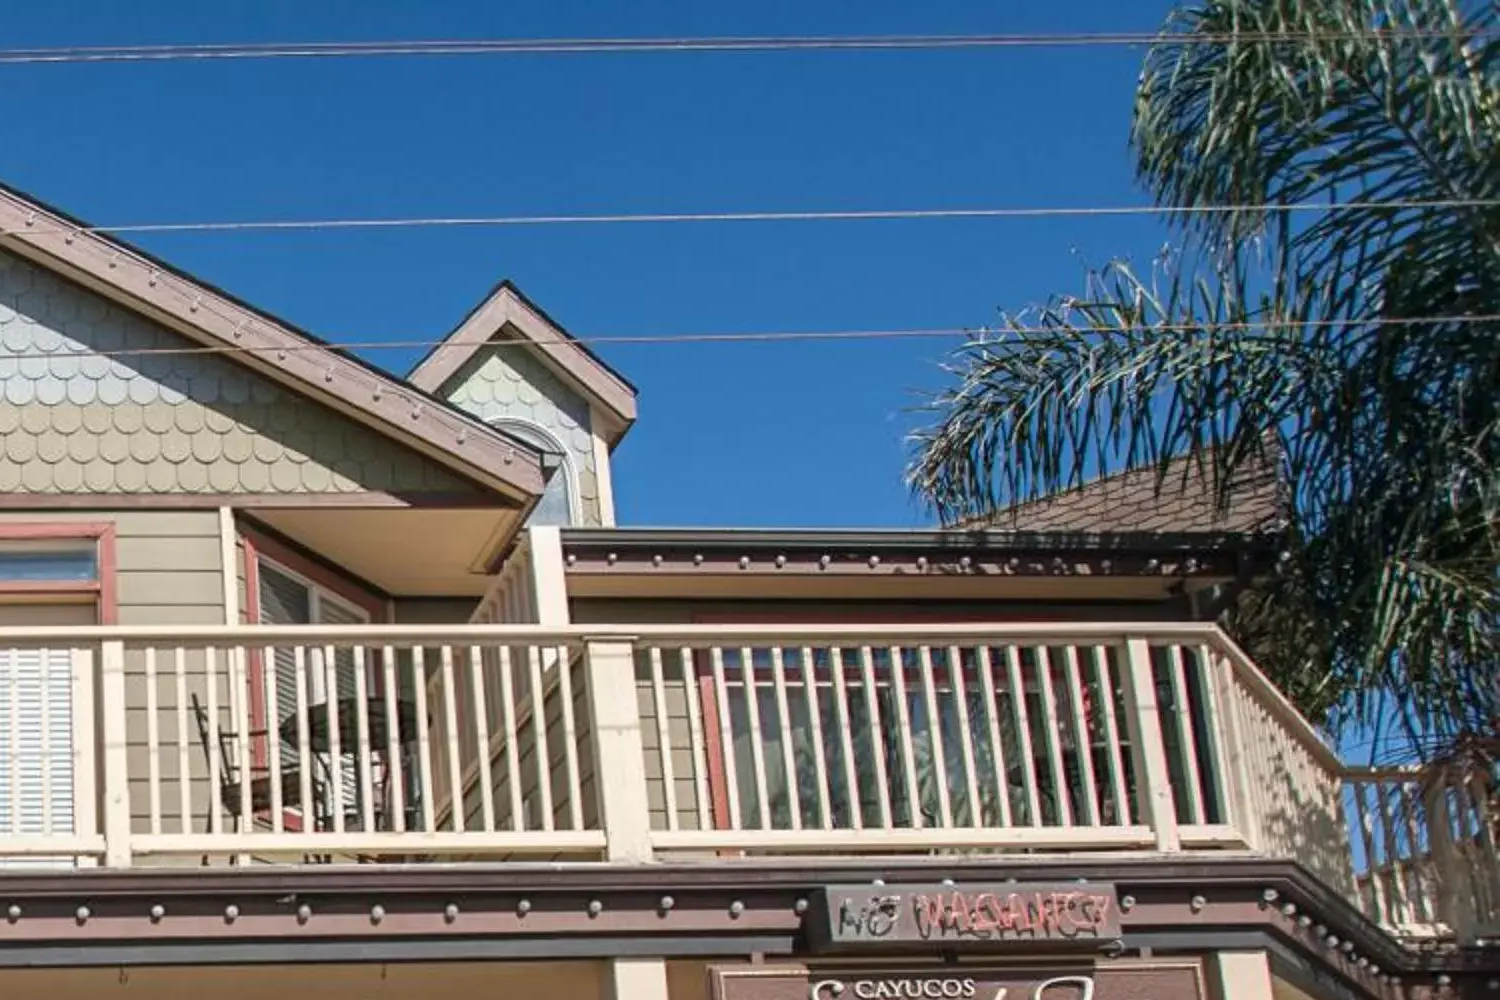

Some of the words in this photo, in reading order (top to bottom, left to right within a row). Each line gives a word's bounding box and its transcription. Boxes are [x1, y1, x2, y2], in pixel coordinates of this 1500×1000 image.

[838, 894, 901, 937] NO
[910, 891, 1116, 939] VACANCY
[854, 978, 976, 999] CAYUCOS
